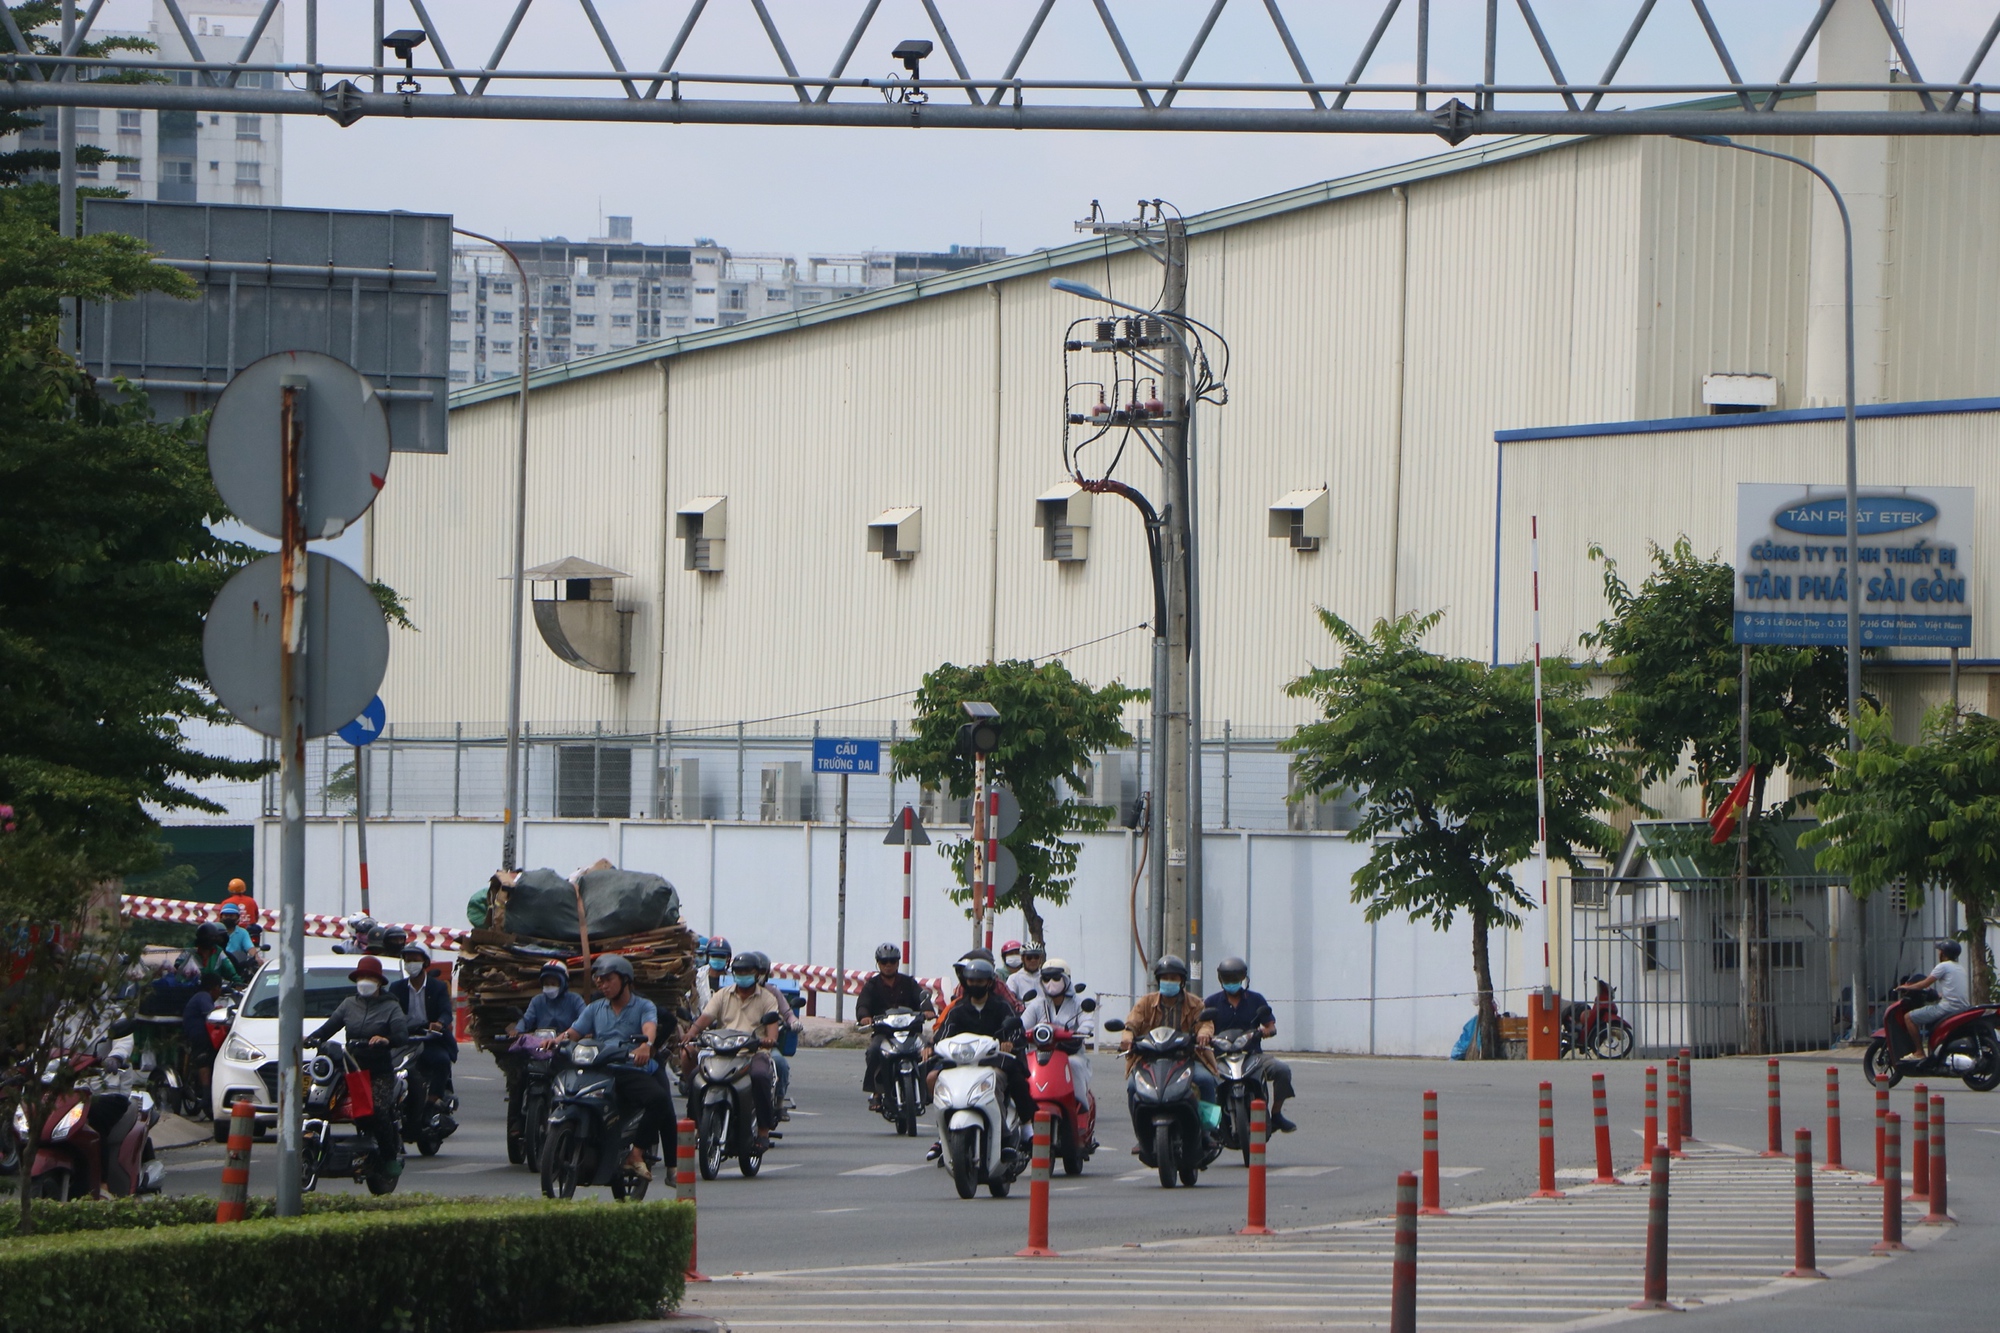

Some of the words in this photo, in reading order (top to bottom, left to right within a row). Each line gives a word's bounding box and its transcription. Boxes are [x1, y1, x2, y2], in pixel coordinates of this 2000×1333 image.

[1787, 507, 1823, 521] TÂN
[1880, 511, 1924, 523] ETEK
[1751, 540, 1800, 562] CÔNG
[1805, 546, 1828, 562] TY
[1885, 540, 1934, 564] THIẾT
[1938, 547, 1956, 569] BỊ
[1744, 569, 1791, 600] TÂN
[1798, 568, 1862, 602] PHÁ
[1866, 567, 1905, 602] SÀI
[1911, 569, 1965, 603] GÒN
[1754, 616, 1766, 626] Số
[1767, 618, 1772, 626] 1
[1773, 617, 1784, 626] Lê
[1785, 618, 1803, 627] Đức
[1804, 618, 1820, 629] Thọ
[1827, 619, 1847, 628] Q.12
[1881, 619, 1895, 628] Chí
[1896, 620, 1917, 629] Minh
[1924, 621, 1941, 631] Việt
[1944, 622, 1963, 630] Nam
[817, 756, 854, 770] TRƯỜNG
